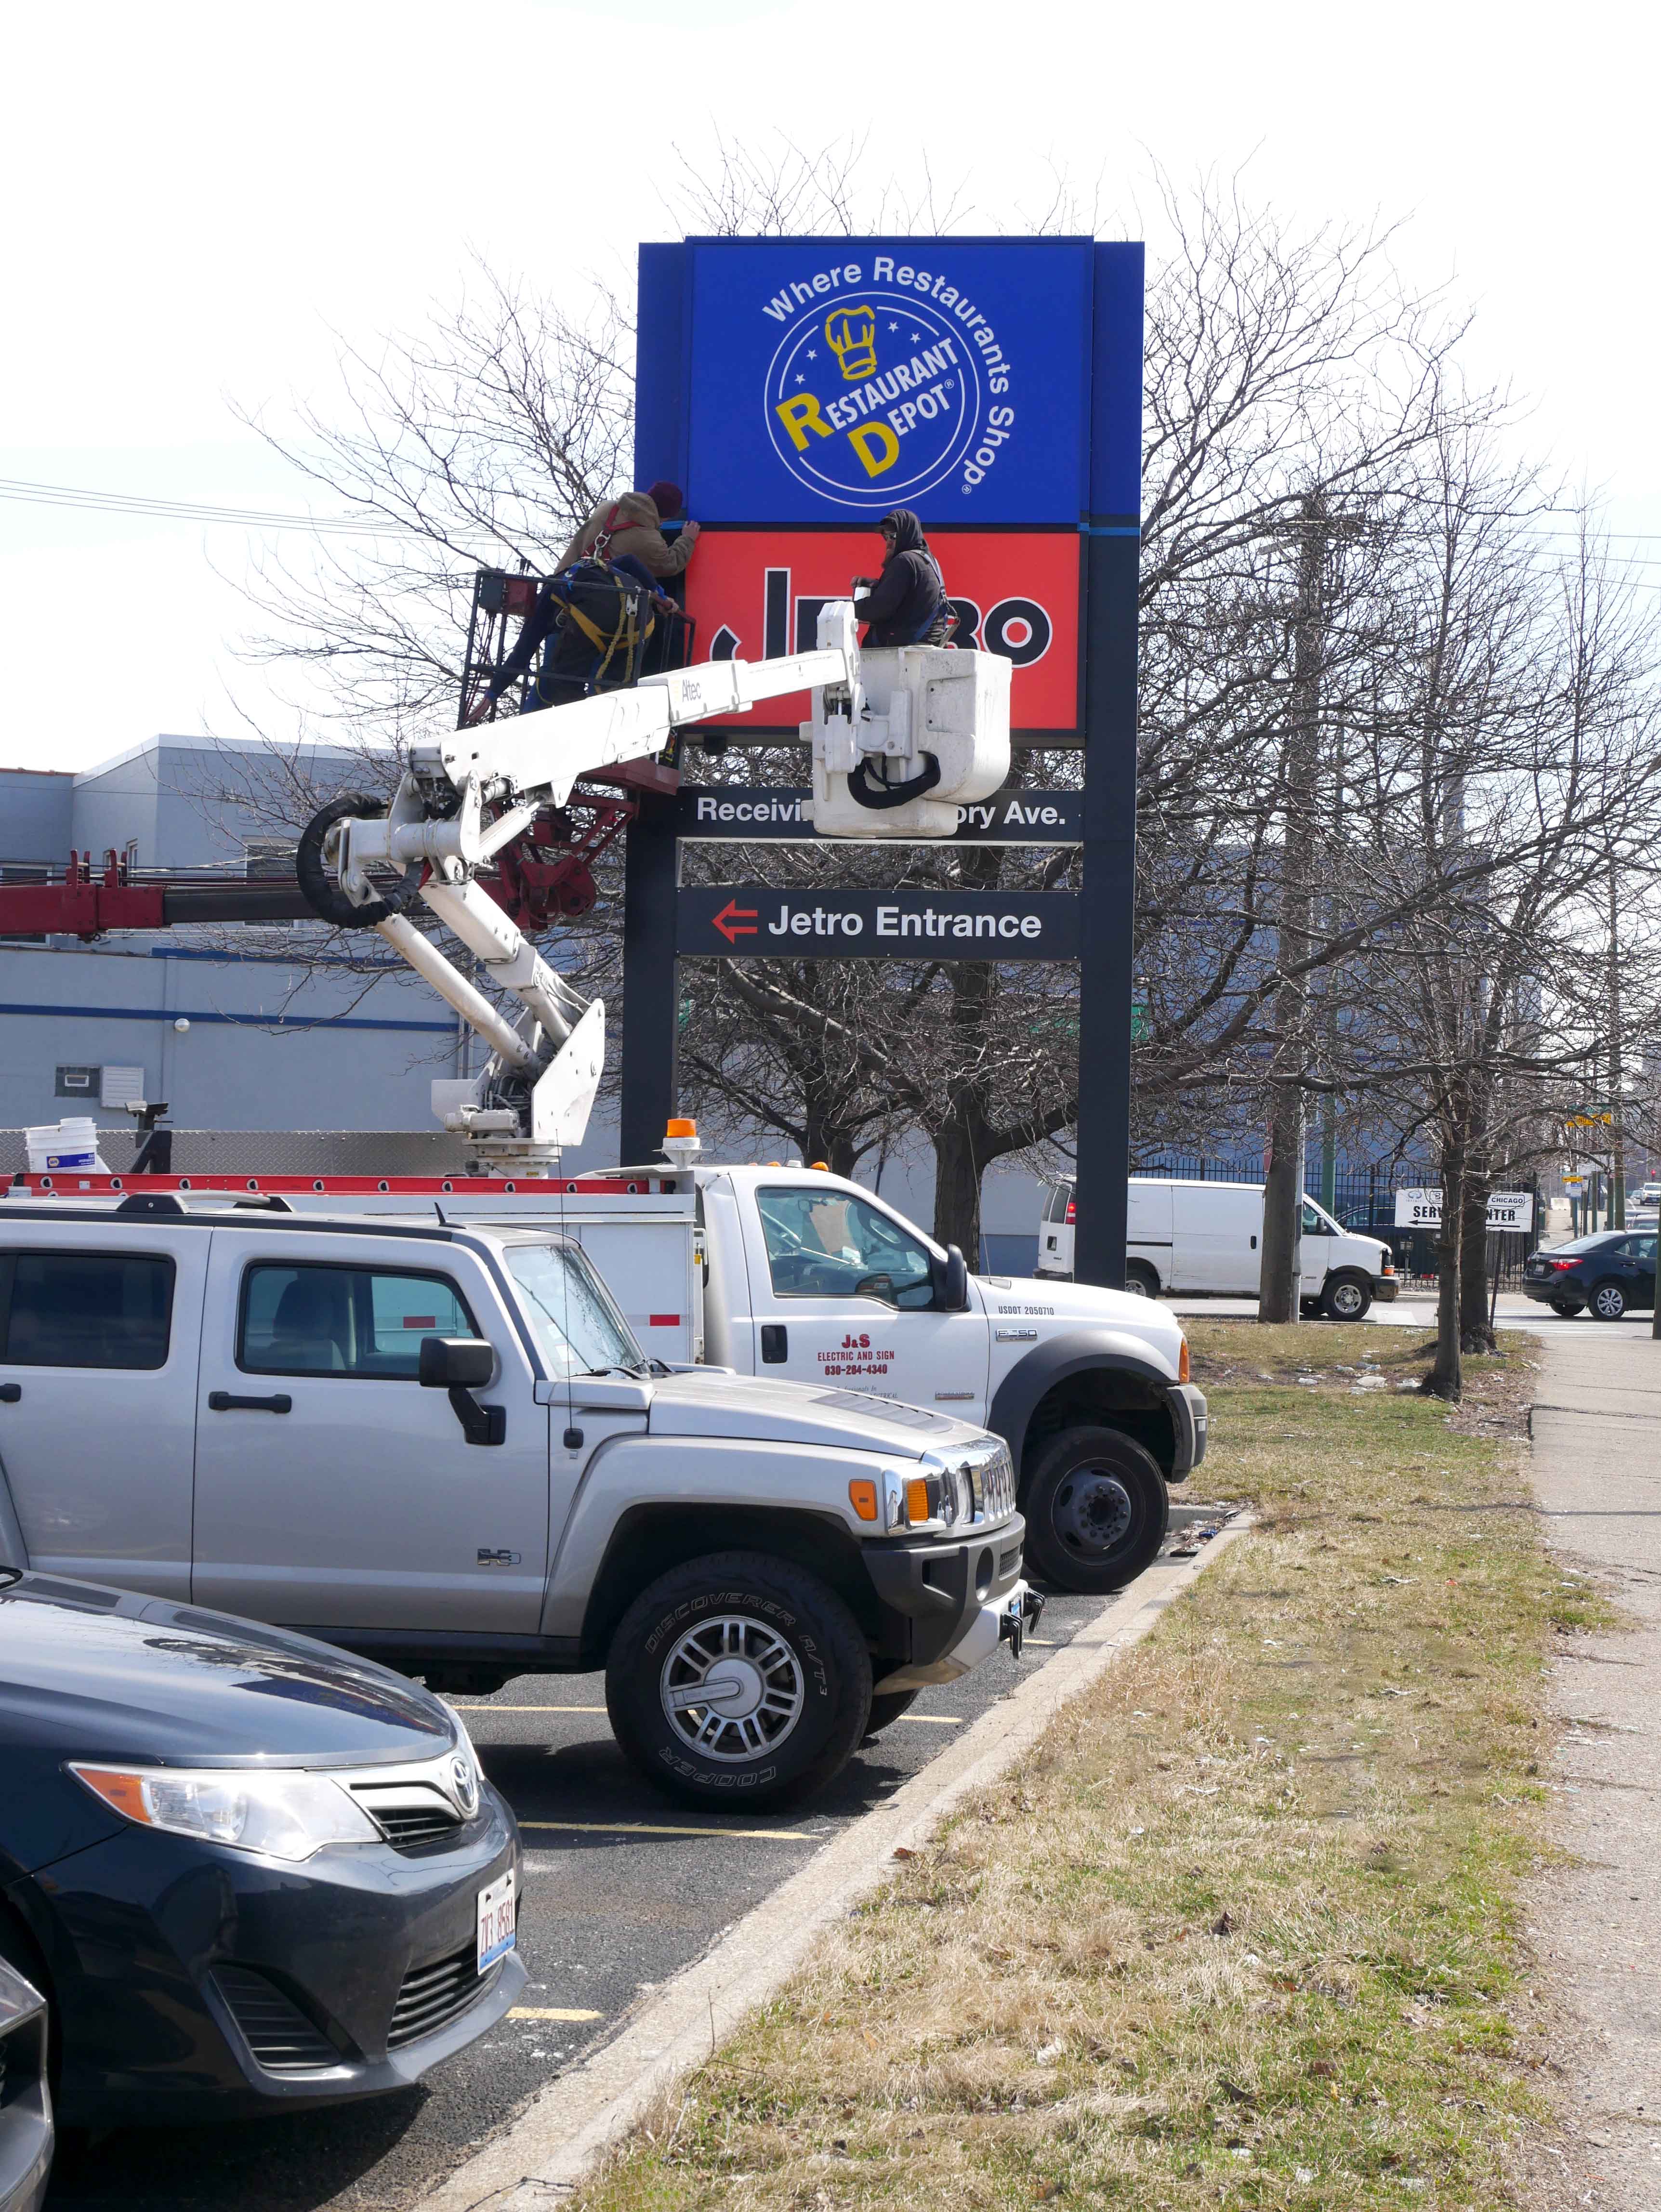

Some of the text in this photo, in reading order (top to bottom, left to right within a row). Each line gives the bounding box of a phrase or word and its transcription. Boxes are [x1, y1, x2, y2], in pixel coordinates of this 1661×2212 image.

[763, 263, 862, 324] Where
[873, 256, 1010, 395] Restaurants
[775, 337, 959, 452] RESTAURANT
[682, 679, 701, 702] Altec
[698, 796, 801, 822] Receivi
[1003, 802, 1067, 825] Ave.
[768, 905, 1042, 938] Jetro Entrance
[1486, 1209, 1516, 1221] NTER
[998, 1306, 1055, 1315] USDOT 2050710
[817, 1350, 895, 1361] ELECTRIC AND SIGN
[841, 1333, 870, 1349] J&S
[645, 1592, 797, 1654] DISCOVERER
[659, 1746, 776, 1787] COOPER
